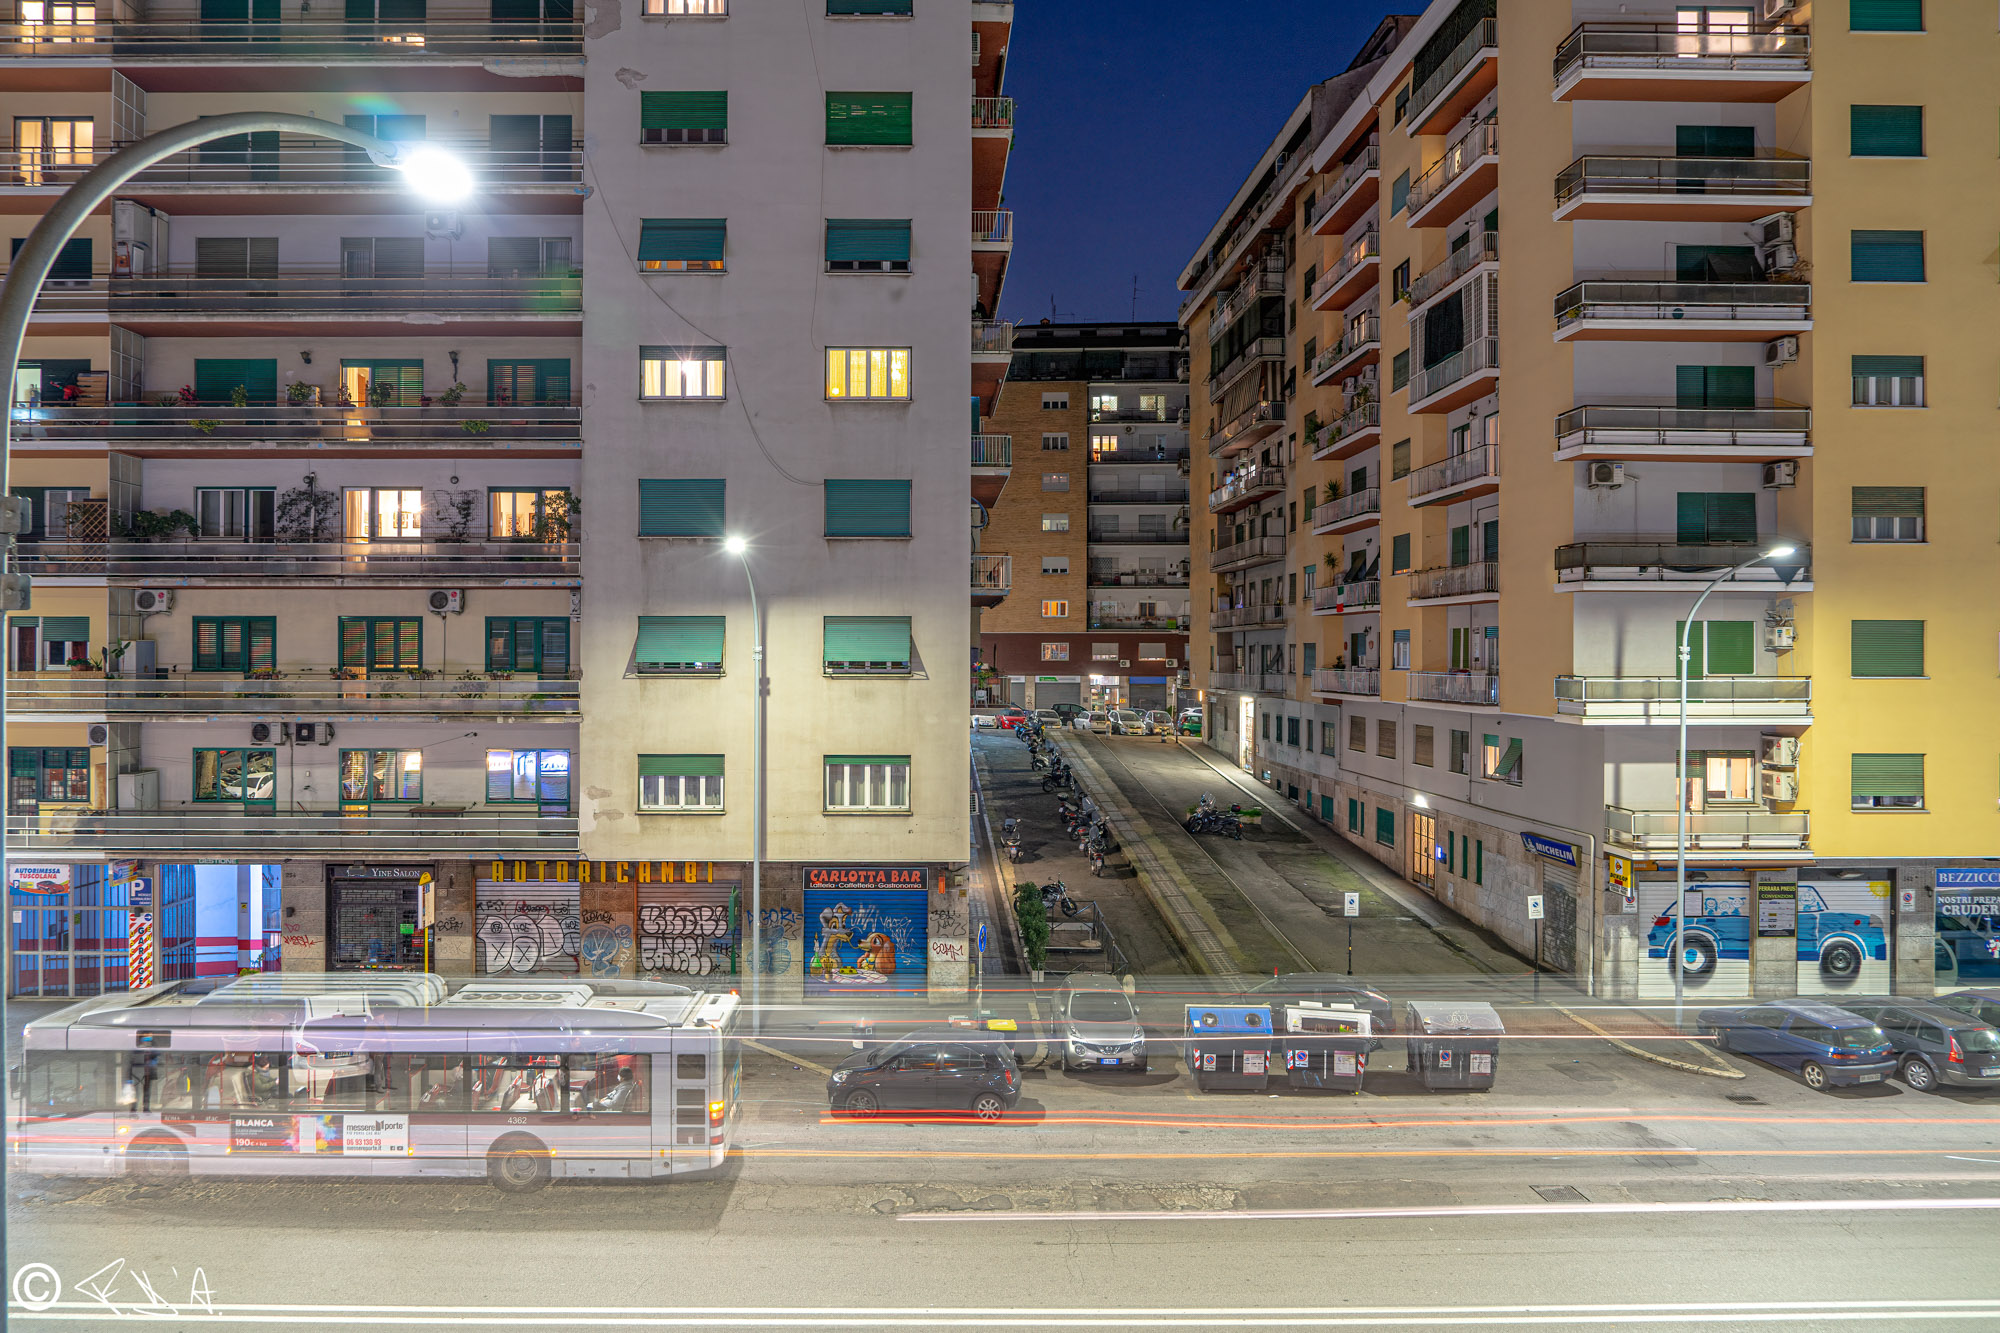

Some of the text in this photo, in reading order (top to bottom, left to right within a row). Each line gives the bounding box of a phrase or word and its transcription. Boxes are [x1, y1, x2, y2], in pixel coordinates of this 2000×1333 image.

[1536, 843, 1573, 860] MICHELIN
[492, 861, 713, 883] AUTORICAMBI
[810, 870, 921, 882] CARLOTTA BAR
[131, 880, 145, 897] P
[235, 1119, 274, 1127] BLANCA
[507, 1116, 527, 1124] 4362
